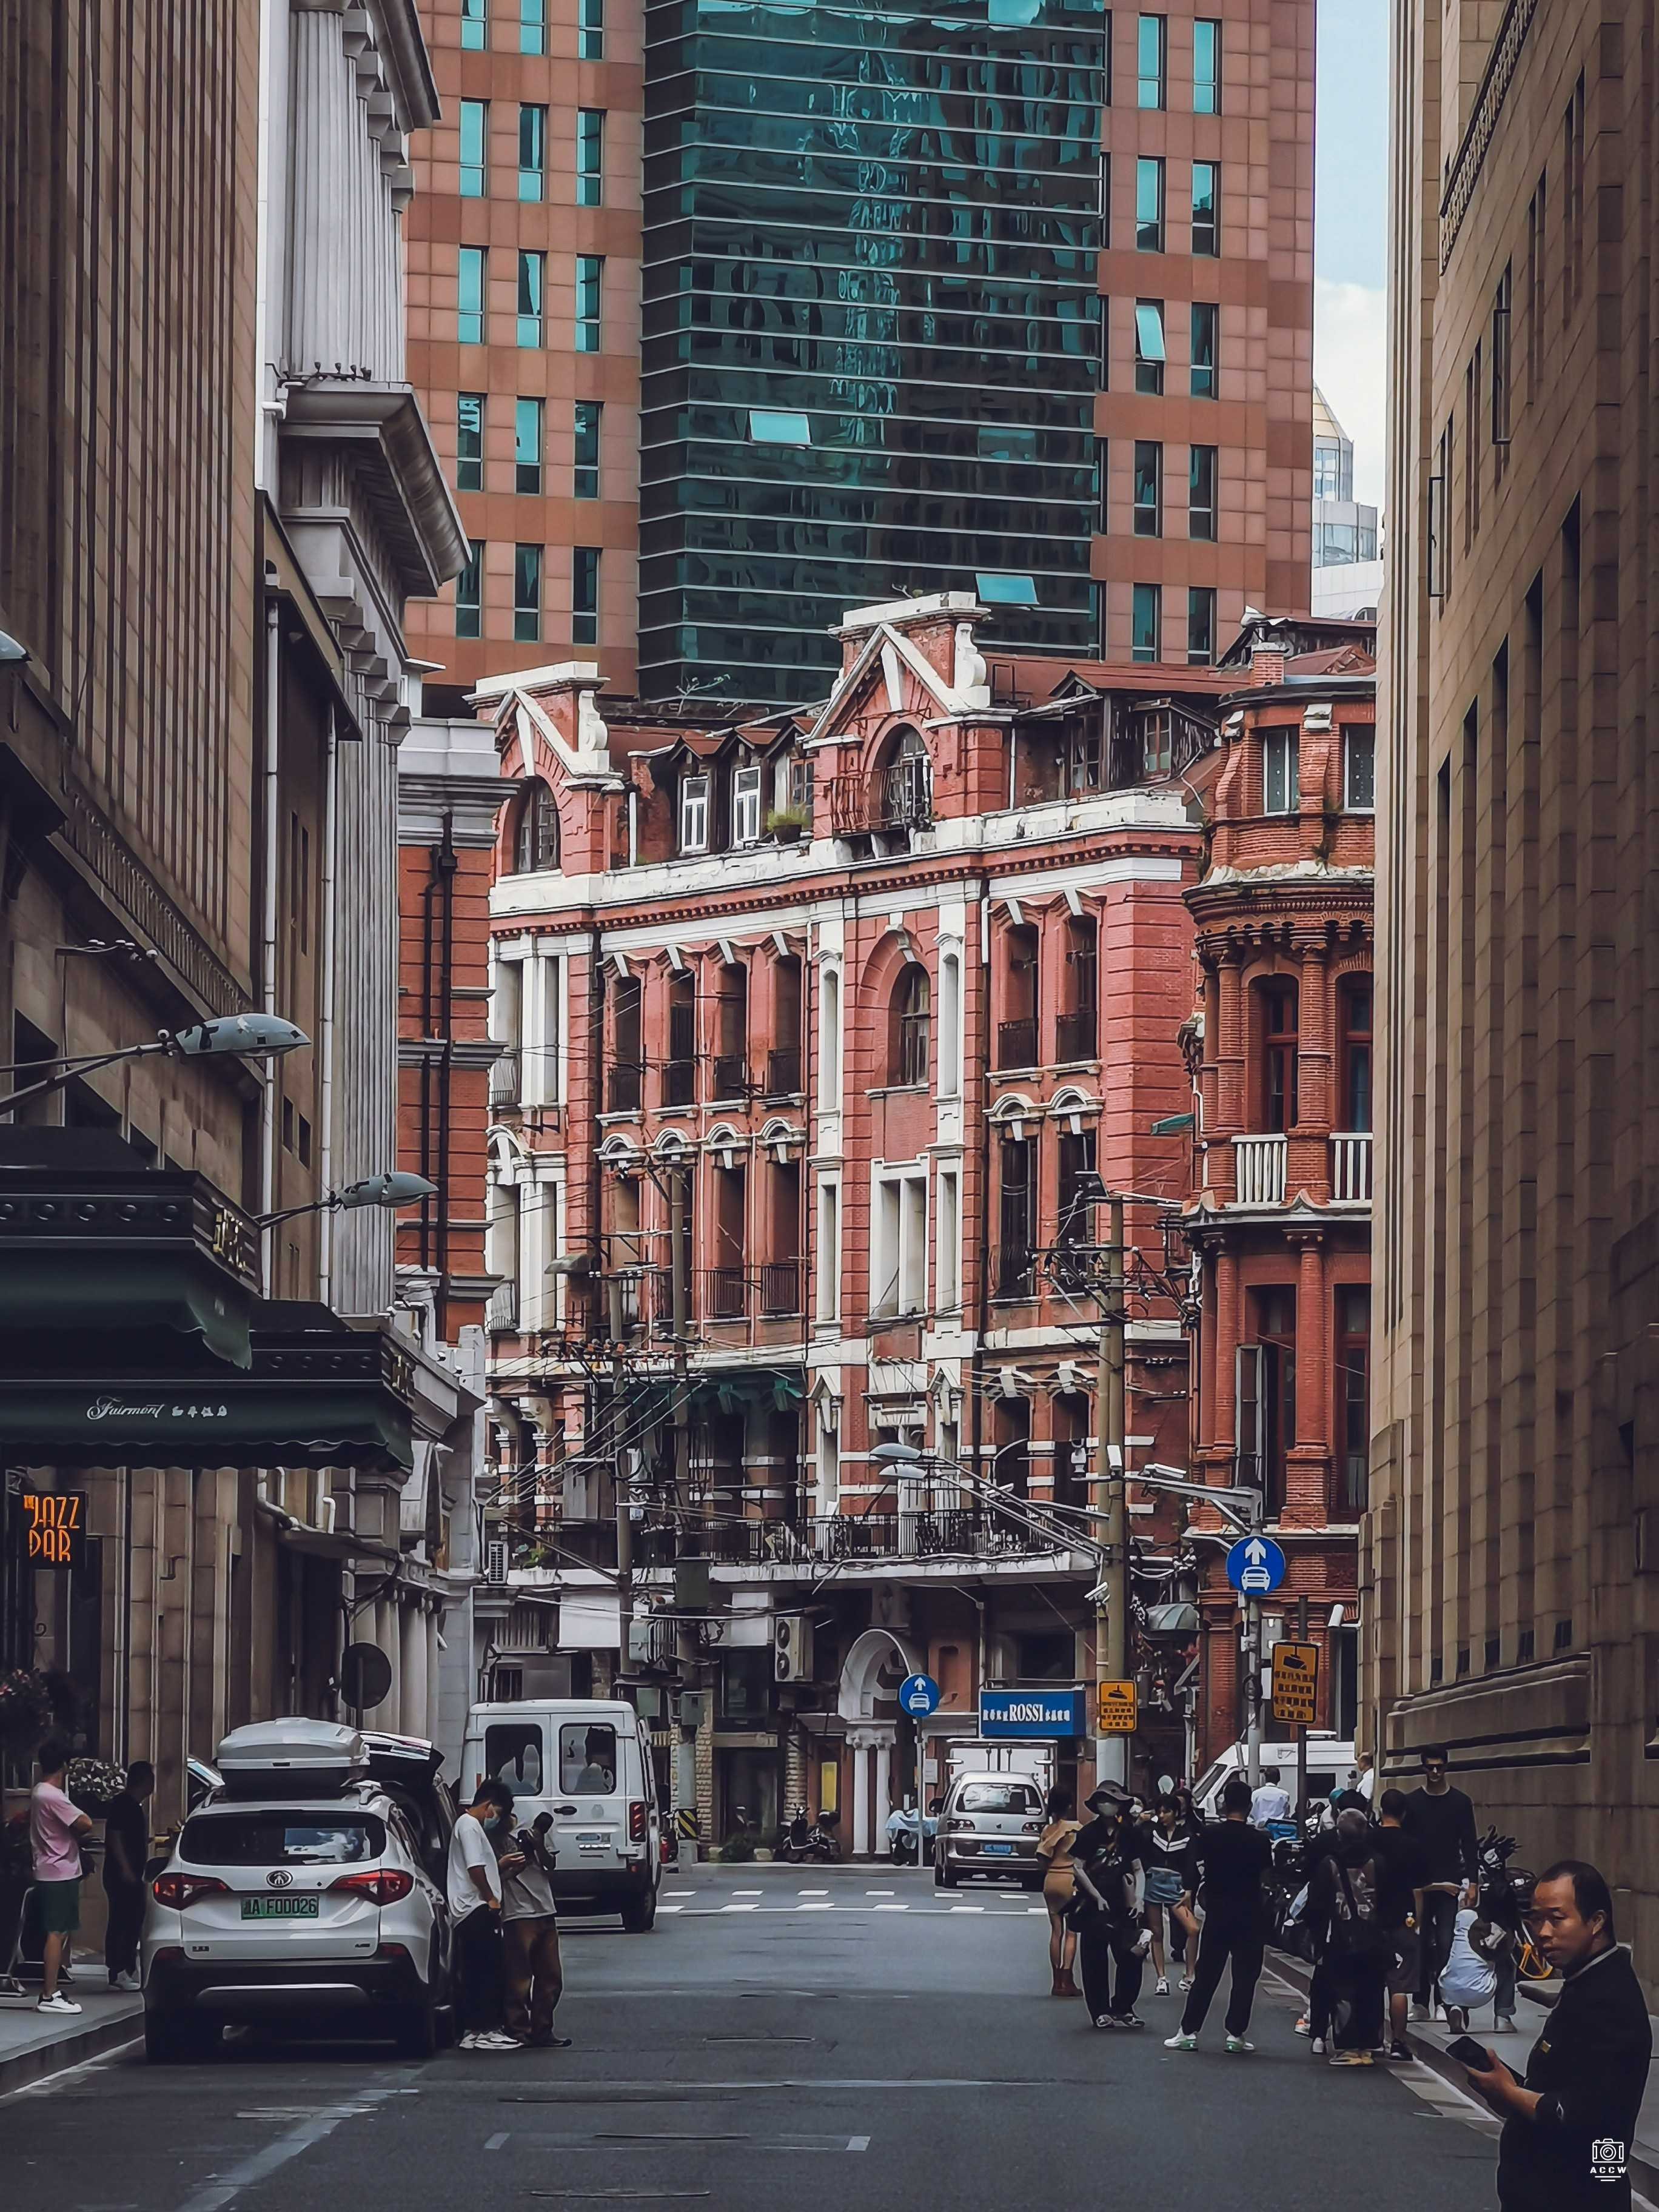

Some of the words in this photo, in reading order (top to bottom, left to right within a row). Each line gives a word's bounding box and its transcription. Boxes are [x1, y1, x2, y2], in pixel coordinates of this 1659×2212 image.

[87, 1396, 165, 1419] Fairmont
[31, 1496, 80, 1529] JAZZ
[1009, 1703, 1044, 1722] ROSSI
